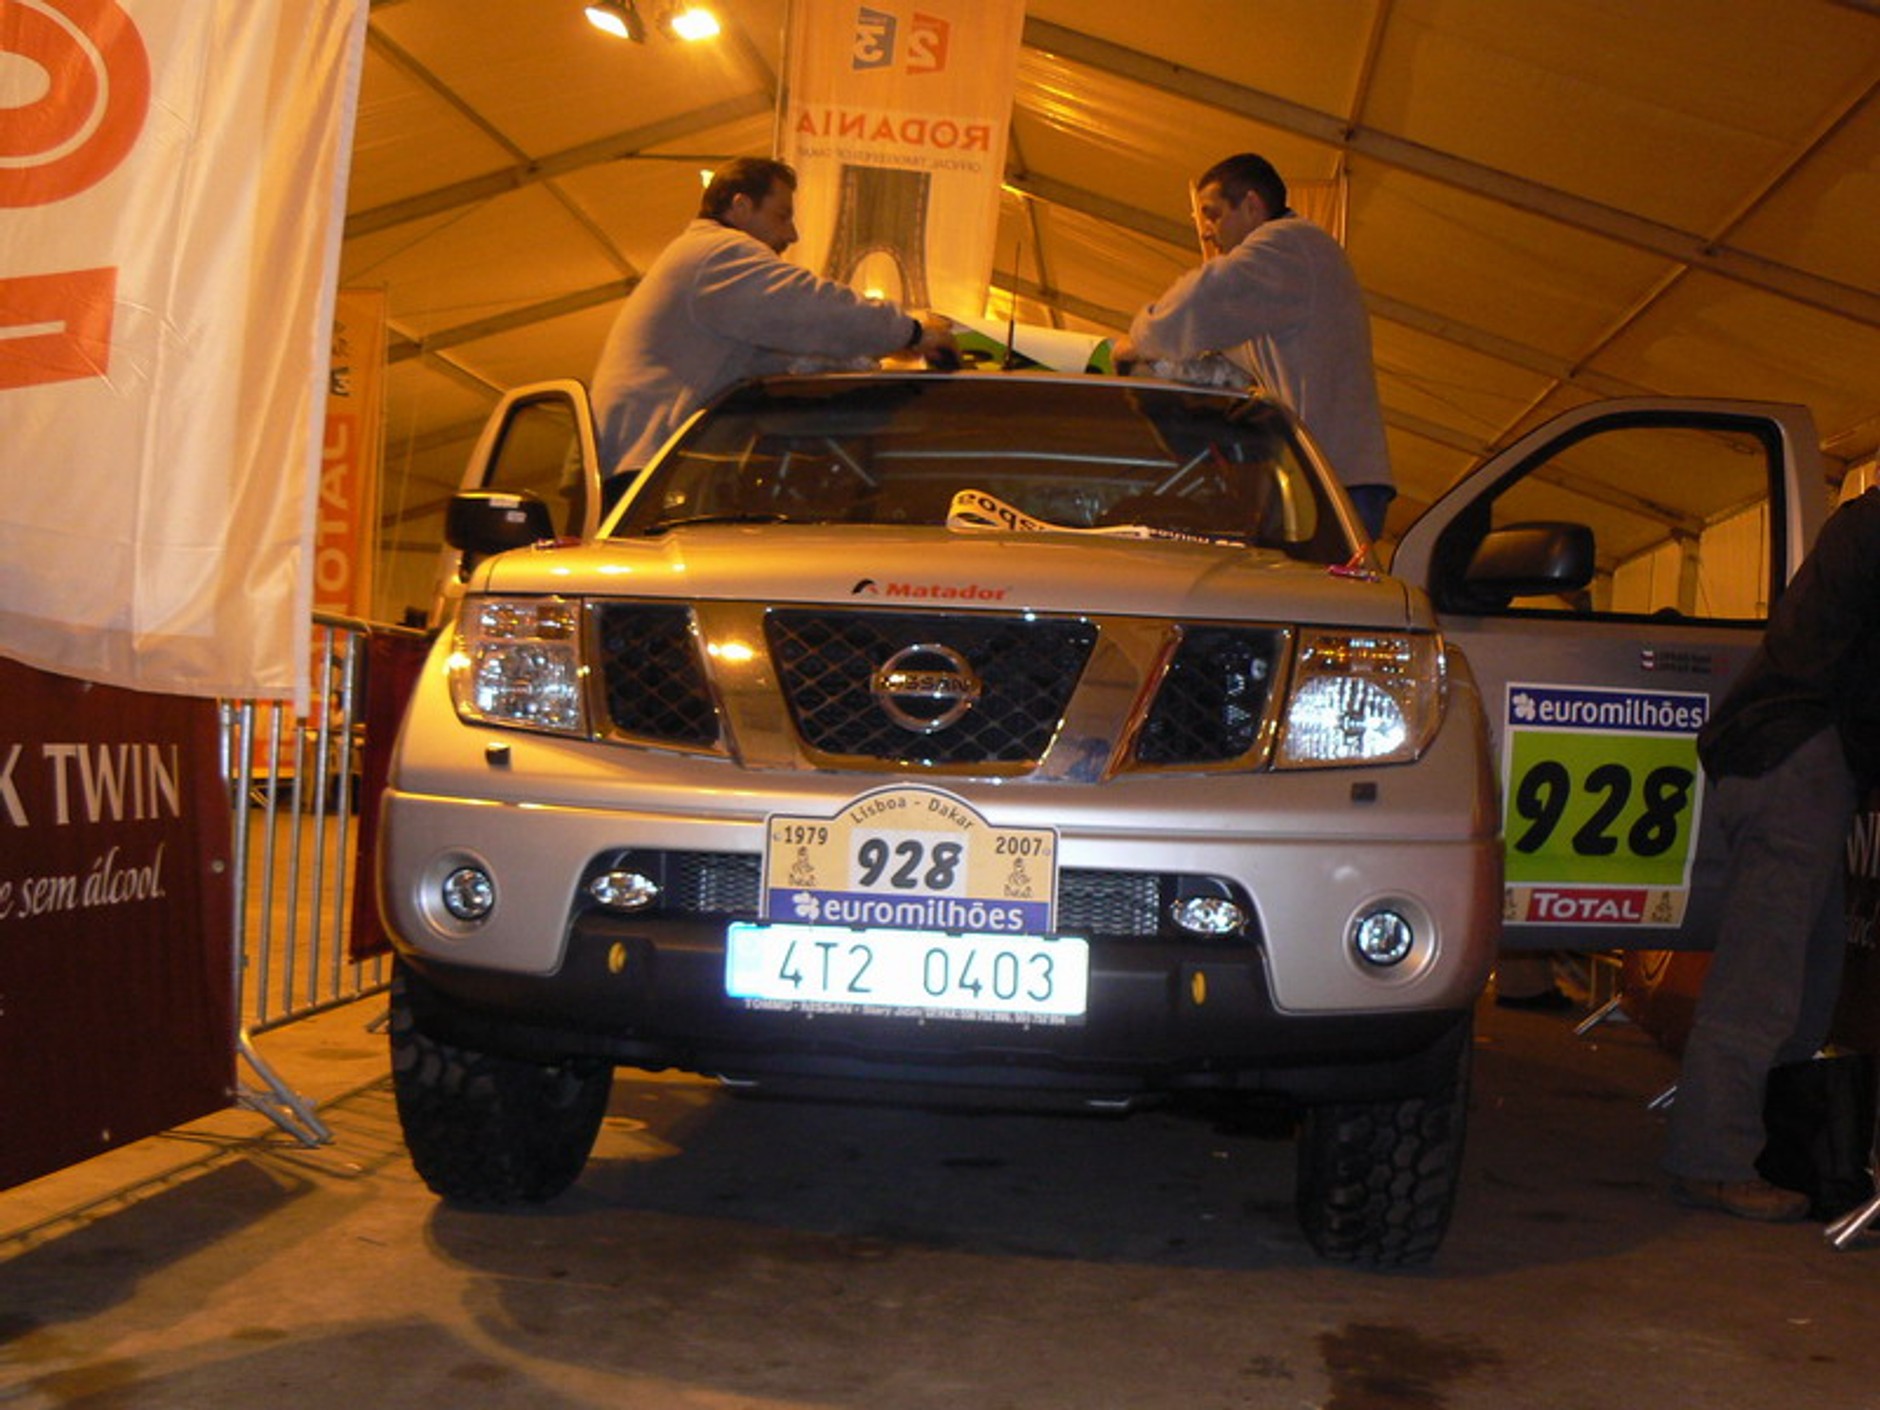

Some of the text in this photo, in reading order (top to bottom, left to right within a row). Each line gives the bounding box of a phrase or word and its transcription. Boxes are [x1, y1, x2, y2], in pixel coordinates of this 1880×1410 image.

[885, 583, 1006, 600] Matador
[1539, 699, 1702, 728] euromilhões
[43, 743, 180, 825] TWIN
[852, 799, 906, 824] Lisboa
[928, 799, 975, 830] Dakar
[1514, 761, 1694, 857] 928
[785, 826, 828, 845] 1979
[996, 837, 1043, 855] 2007
[858, 838, 962, 890] 928
[18, 877, 78, 918] sem
[82, 842, 166, 907] álcool.
[824, 898, 1023, 930] euromilhões
[1534, 893, 1640, 919] TOTAL
[779, 940, 1055, 1002] 4T2 0403
